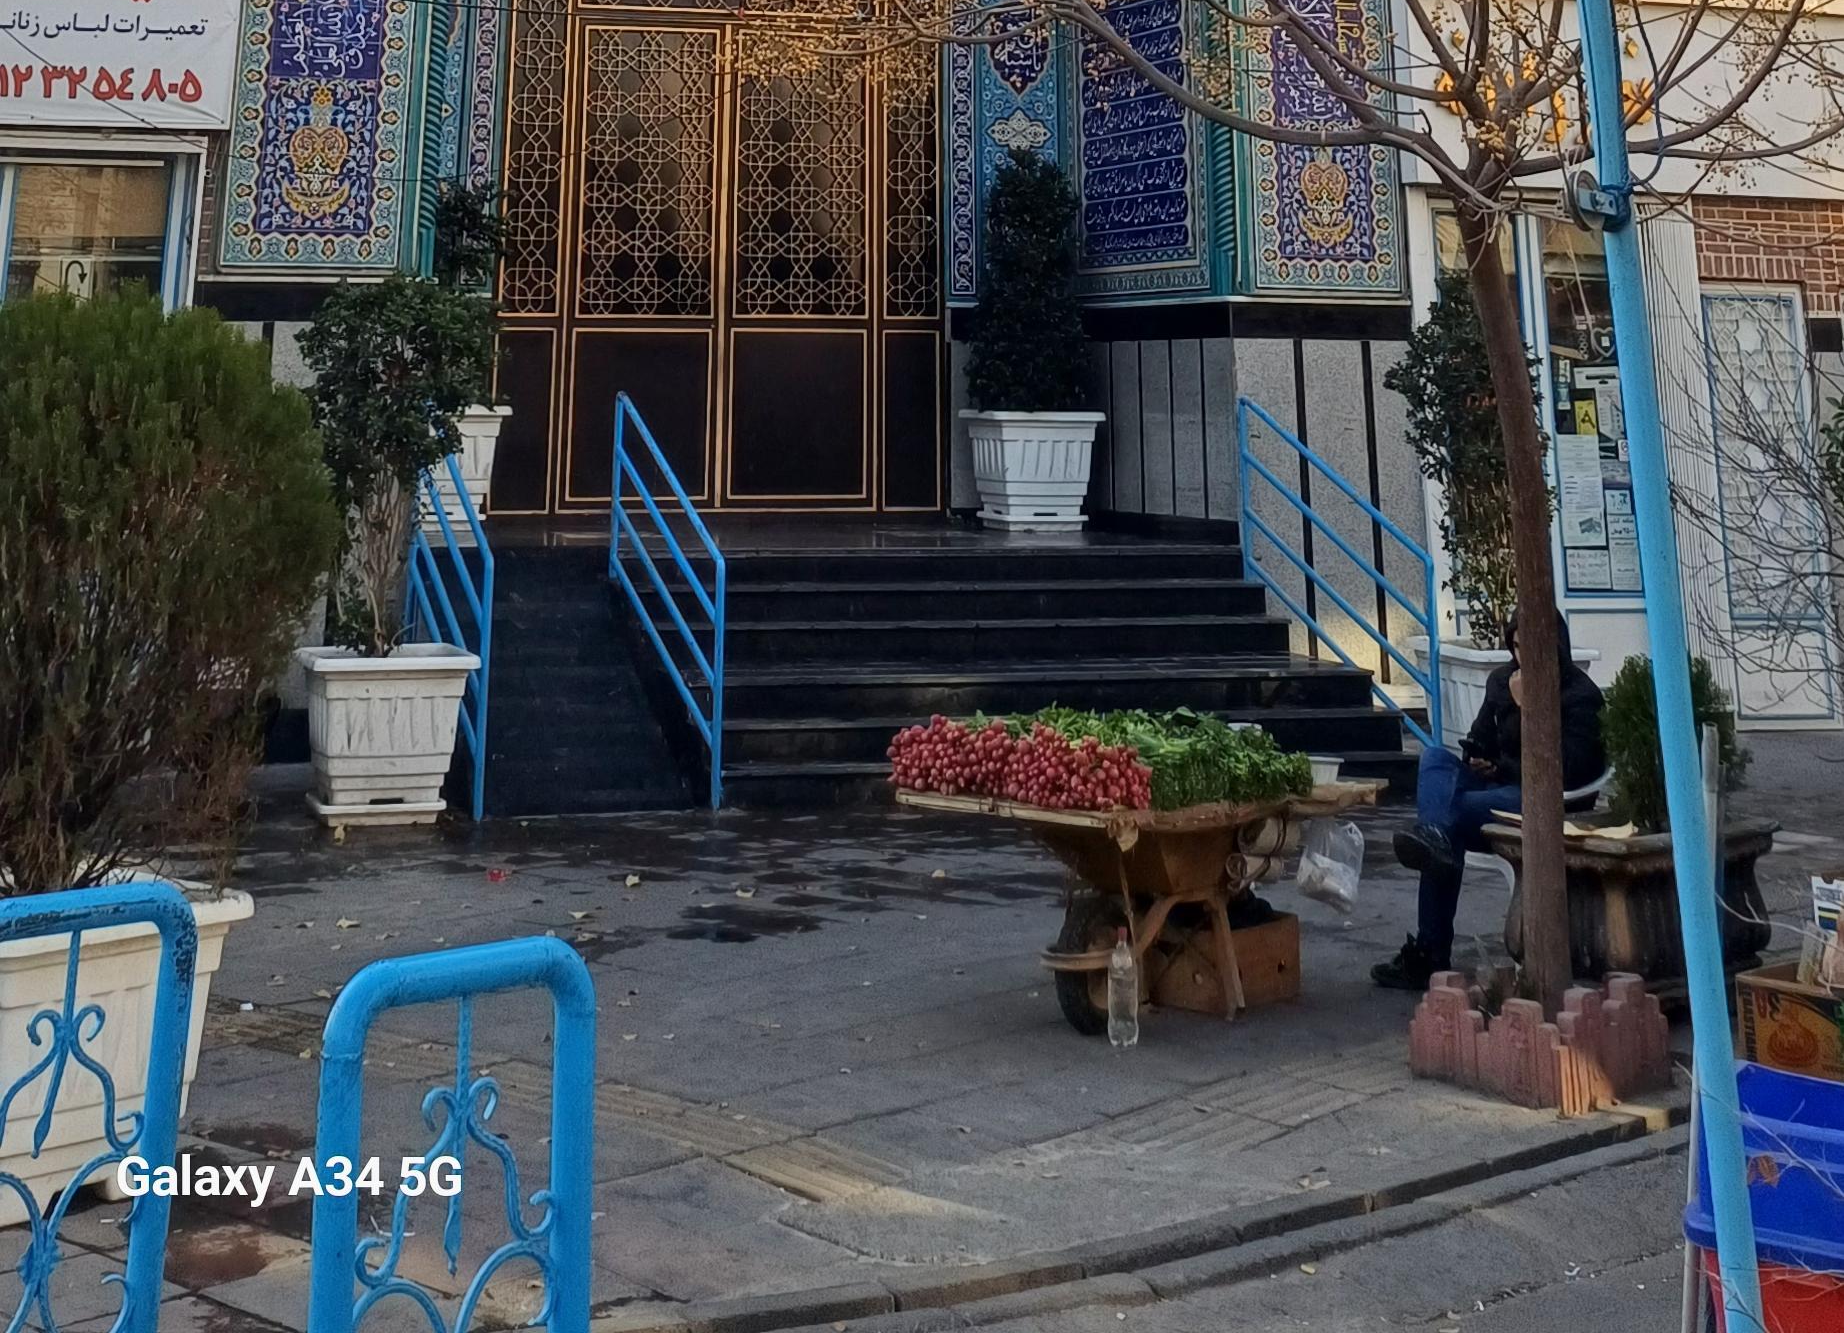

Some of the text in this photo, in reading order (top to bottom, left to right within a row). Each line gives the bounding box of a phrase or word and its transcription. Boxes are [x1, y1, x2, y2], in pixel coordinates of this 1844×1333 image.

[0, 9, 209, 42] تعمیرات لباس زنان
